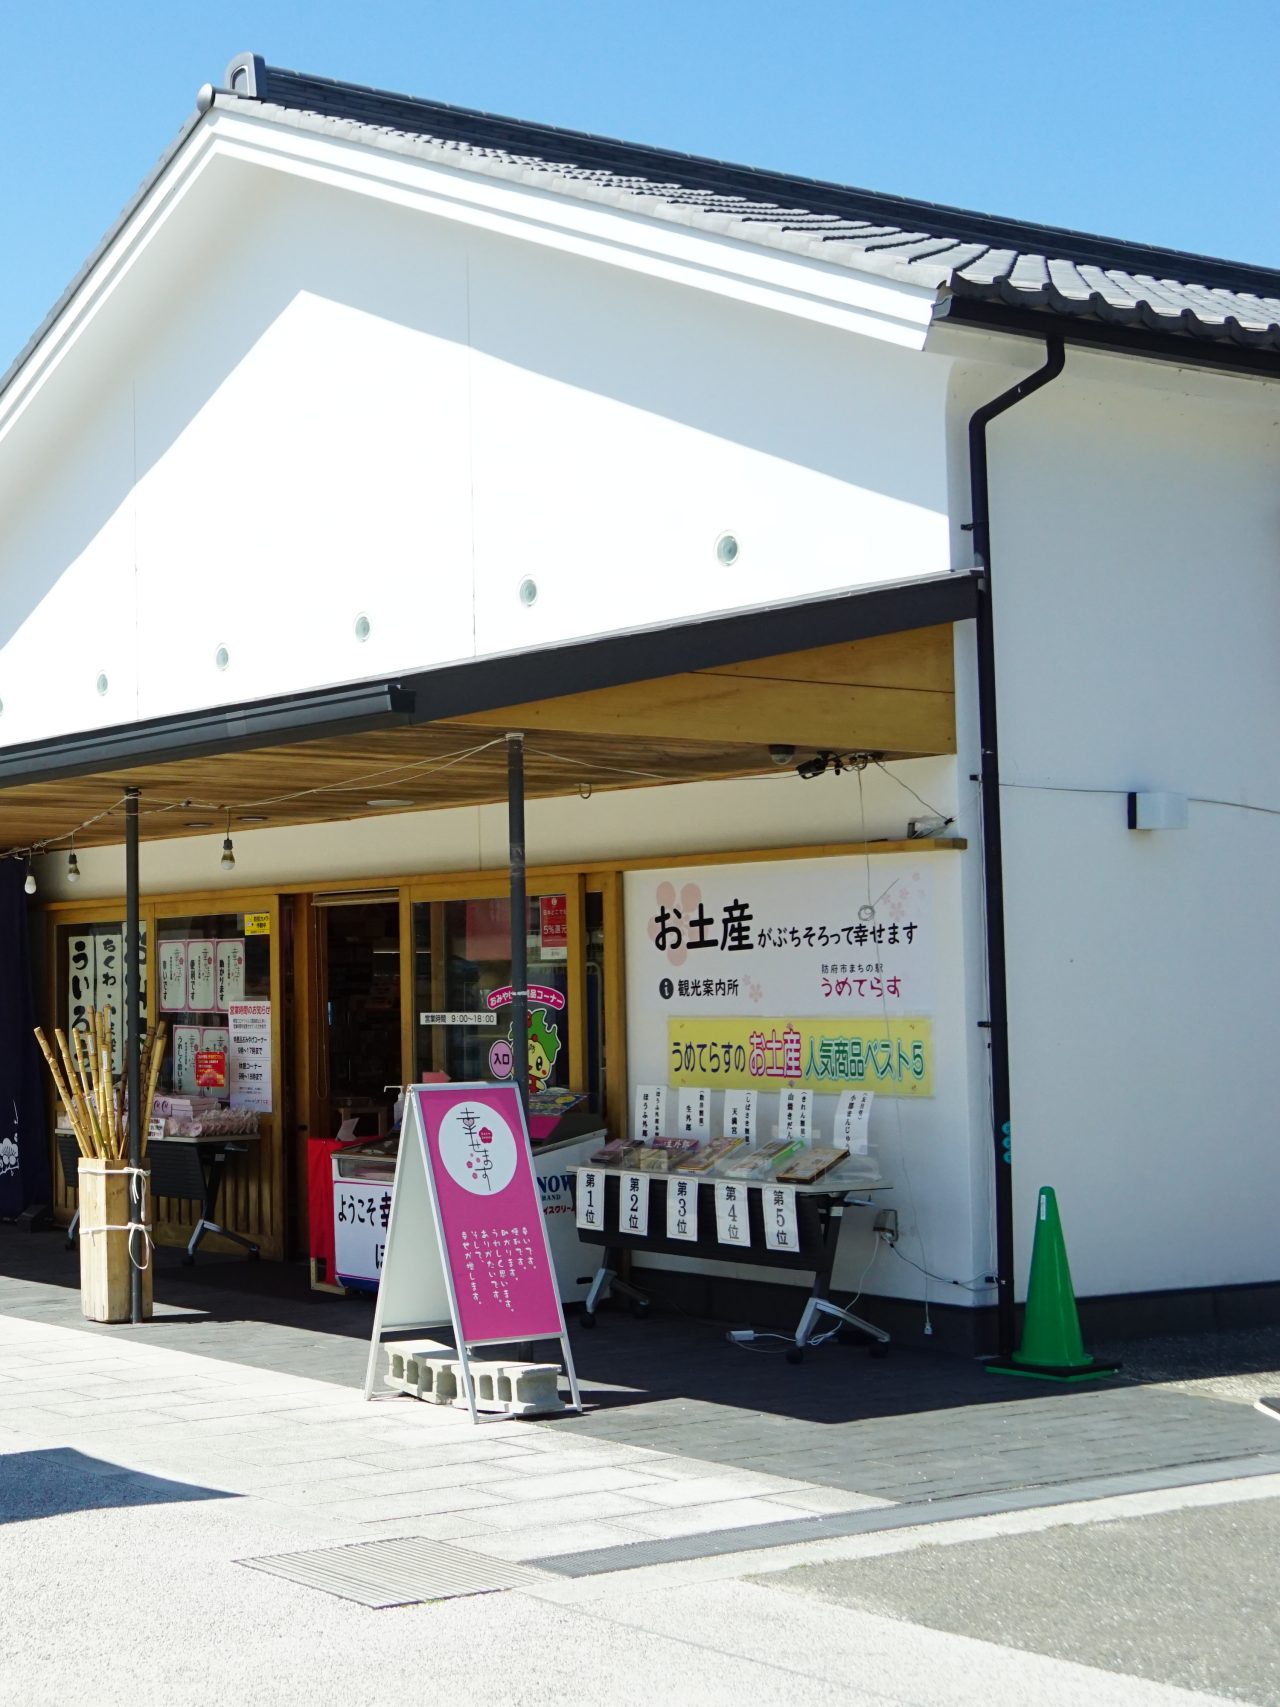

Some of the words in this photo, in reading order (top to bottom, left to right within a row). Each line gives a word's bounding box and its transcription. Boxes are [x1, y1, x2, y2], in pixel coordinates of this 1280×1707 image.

[677, 978, 740, 997] 観光案内所
[820, 975, 902, 998] うめてらす
[821, 963, 884, 974] 防府市まちの駅
[424, 1014, 447, 1023] 営業時間
[493, 1052, 510, 1065] 入口
[584, 1172, 596, 1226] 第1位
[628, 1176, 640, 1230] 第2位
[676, 1181, 688, 1236] 第3位
[725, 1185, 740, 1241] 第4位
[773, 1189, 789, 1246] 第5位
